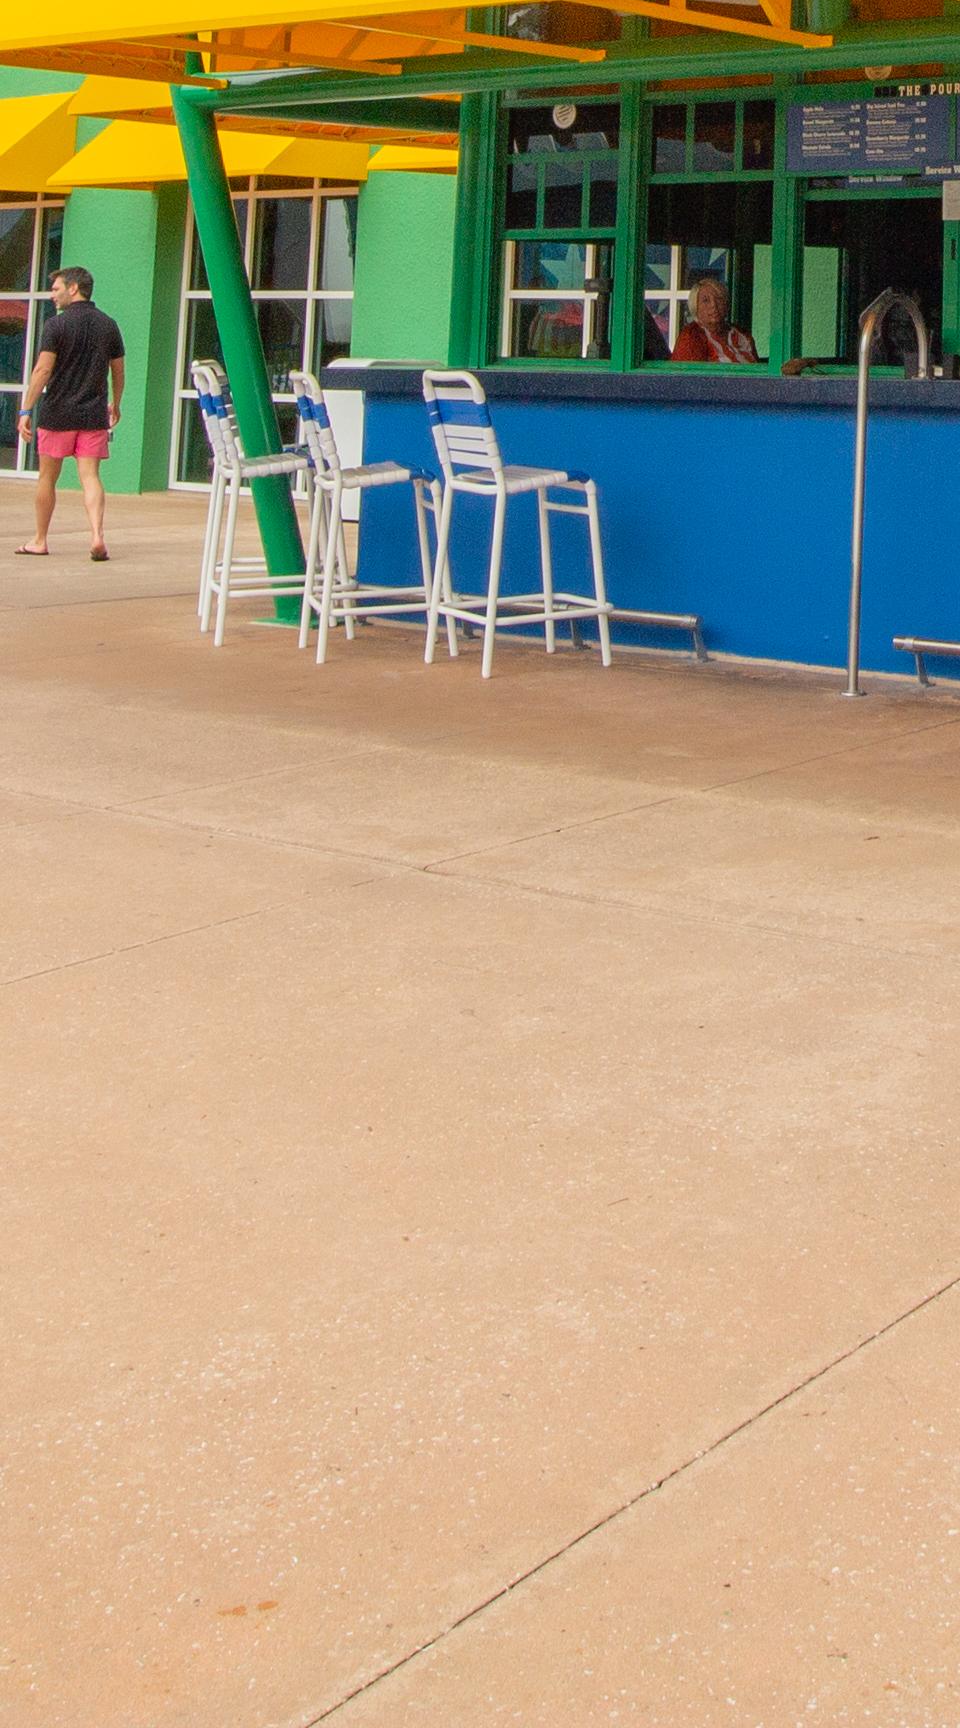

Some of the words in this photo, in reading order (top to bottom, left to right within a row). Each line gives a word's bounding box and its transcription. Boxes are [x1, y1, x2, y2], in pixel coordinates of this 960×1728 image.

[898, 85, 921, 97] THE
[930, 83, 960, 95] POUR
[925, 166, 952, 175] Service
